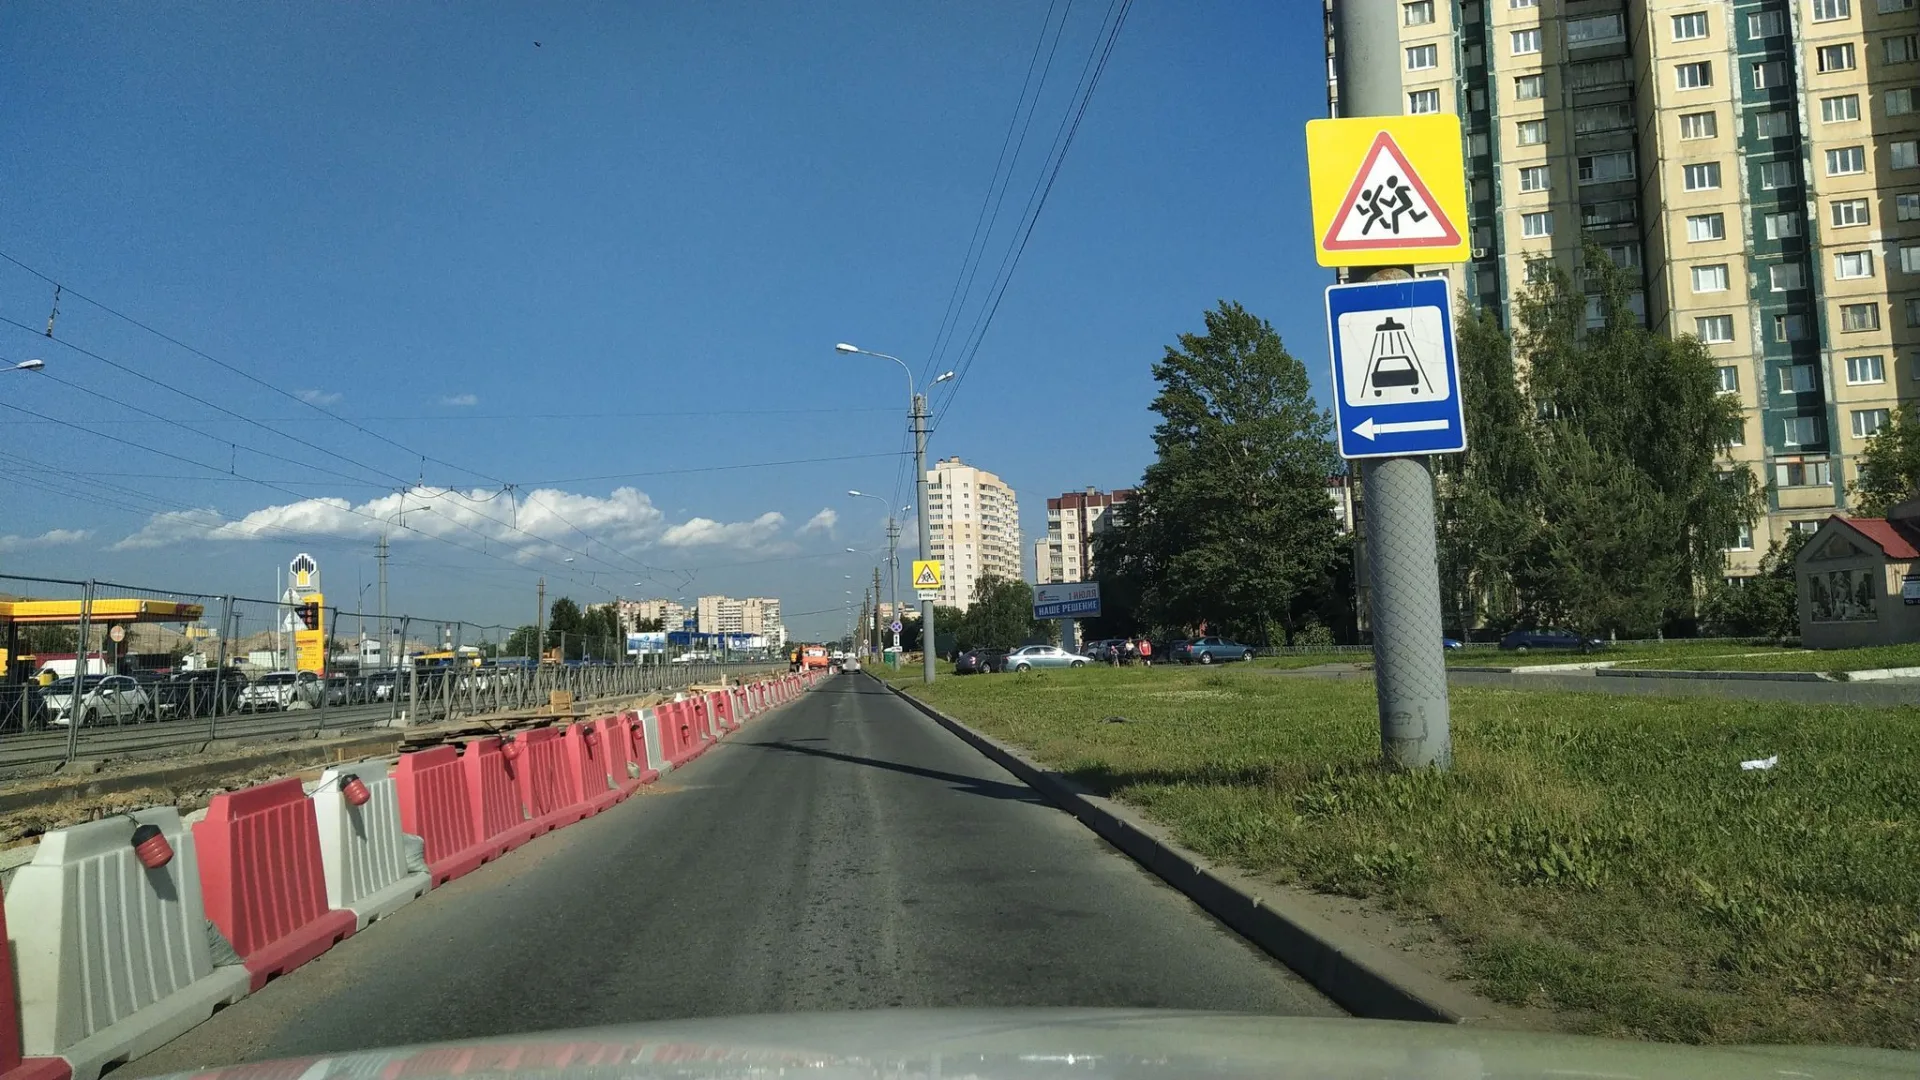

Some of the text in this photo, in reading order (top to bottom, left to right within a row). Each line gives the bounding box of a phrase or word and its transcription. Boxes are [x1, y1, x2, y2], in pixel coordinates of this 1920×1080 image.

[1072, 589, 1097, 600] ИЮЛЯ
[1039, 600, 1097, 616] НАШЕ РЕШЕНИЕ
